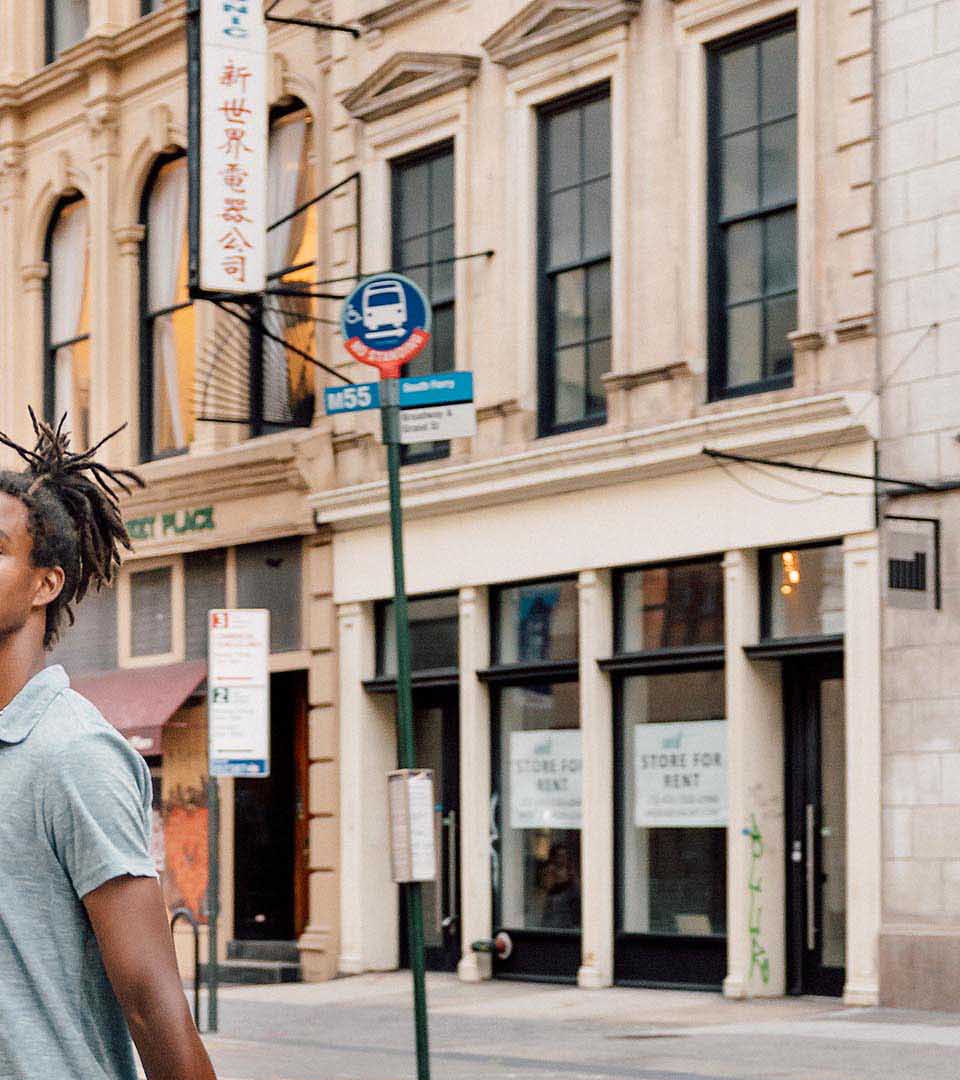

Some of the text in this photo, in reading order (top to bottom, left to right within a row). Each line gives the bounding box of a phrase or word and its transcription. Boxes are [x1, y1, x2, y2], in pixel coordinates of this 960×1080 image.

[327, 386, 372, 411] M55
[516, 759, 559, 773] STORE
[641, 751, 722, 769] STORE FOR
[537, 778, 568, 791] RENT
[664, 773, 699, 788] RENT
